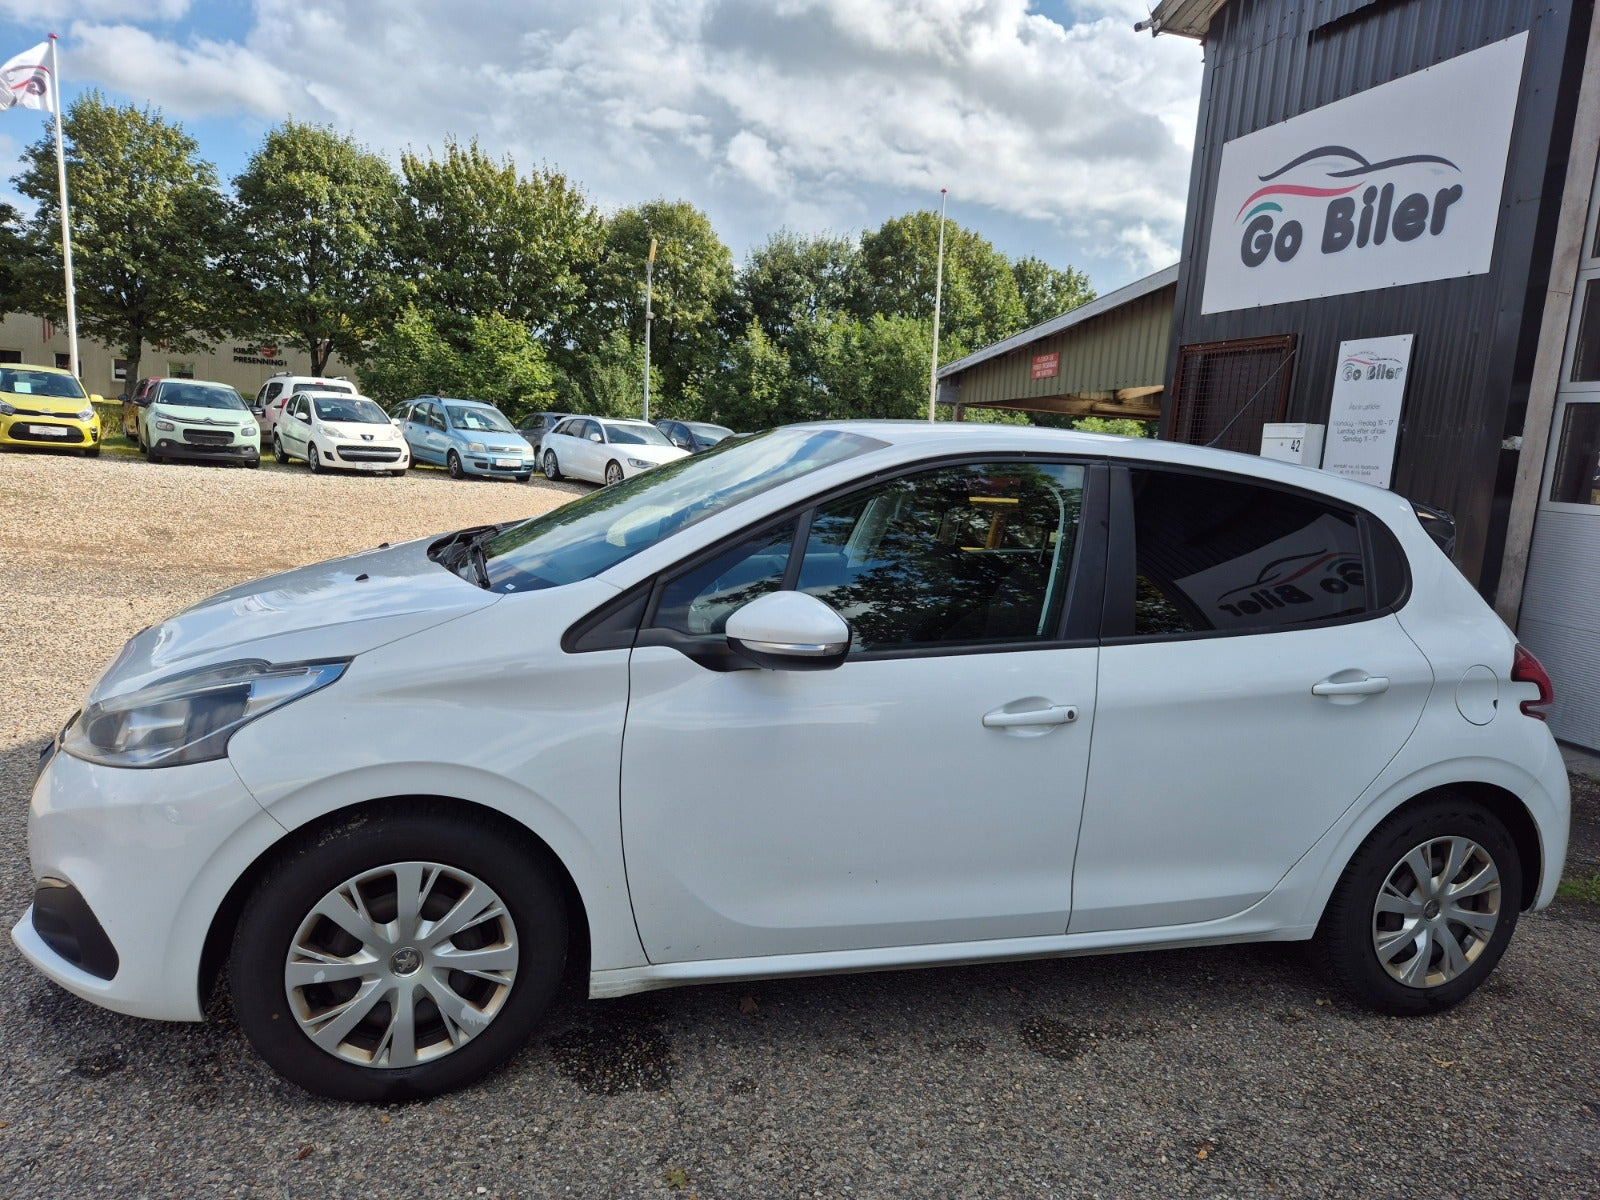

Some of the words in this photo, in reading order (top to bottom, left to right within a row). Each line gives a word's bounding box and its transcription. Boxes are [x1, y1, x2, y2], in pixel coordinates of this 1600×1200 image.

[1240, 215, 1303, 268] Go
[1321, 182, 1464, 255] Biler
[1342, 366, 1362, 381] Go
[1366, 364, 1403, 380] Biler
[1290, 439, 1301, 452] 42
